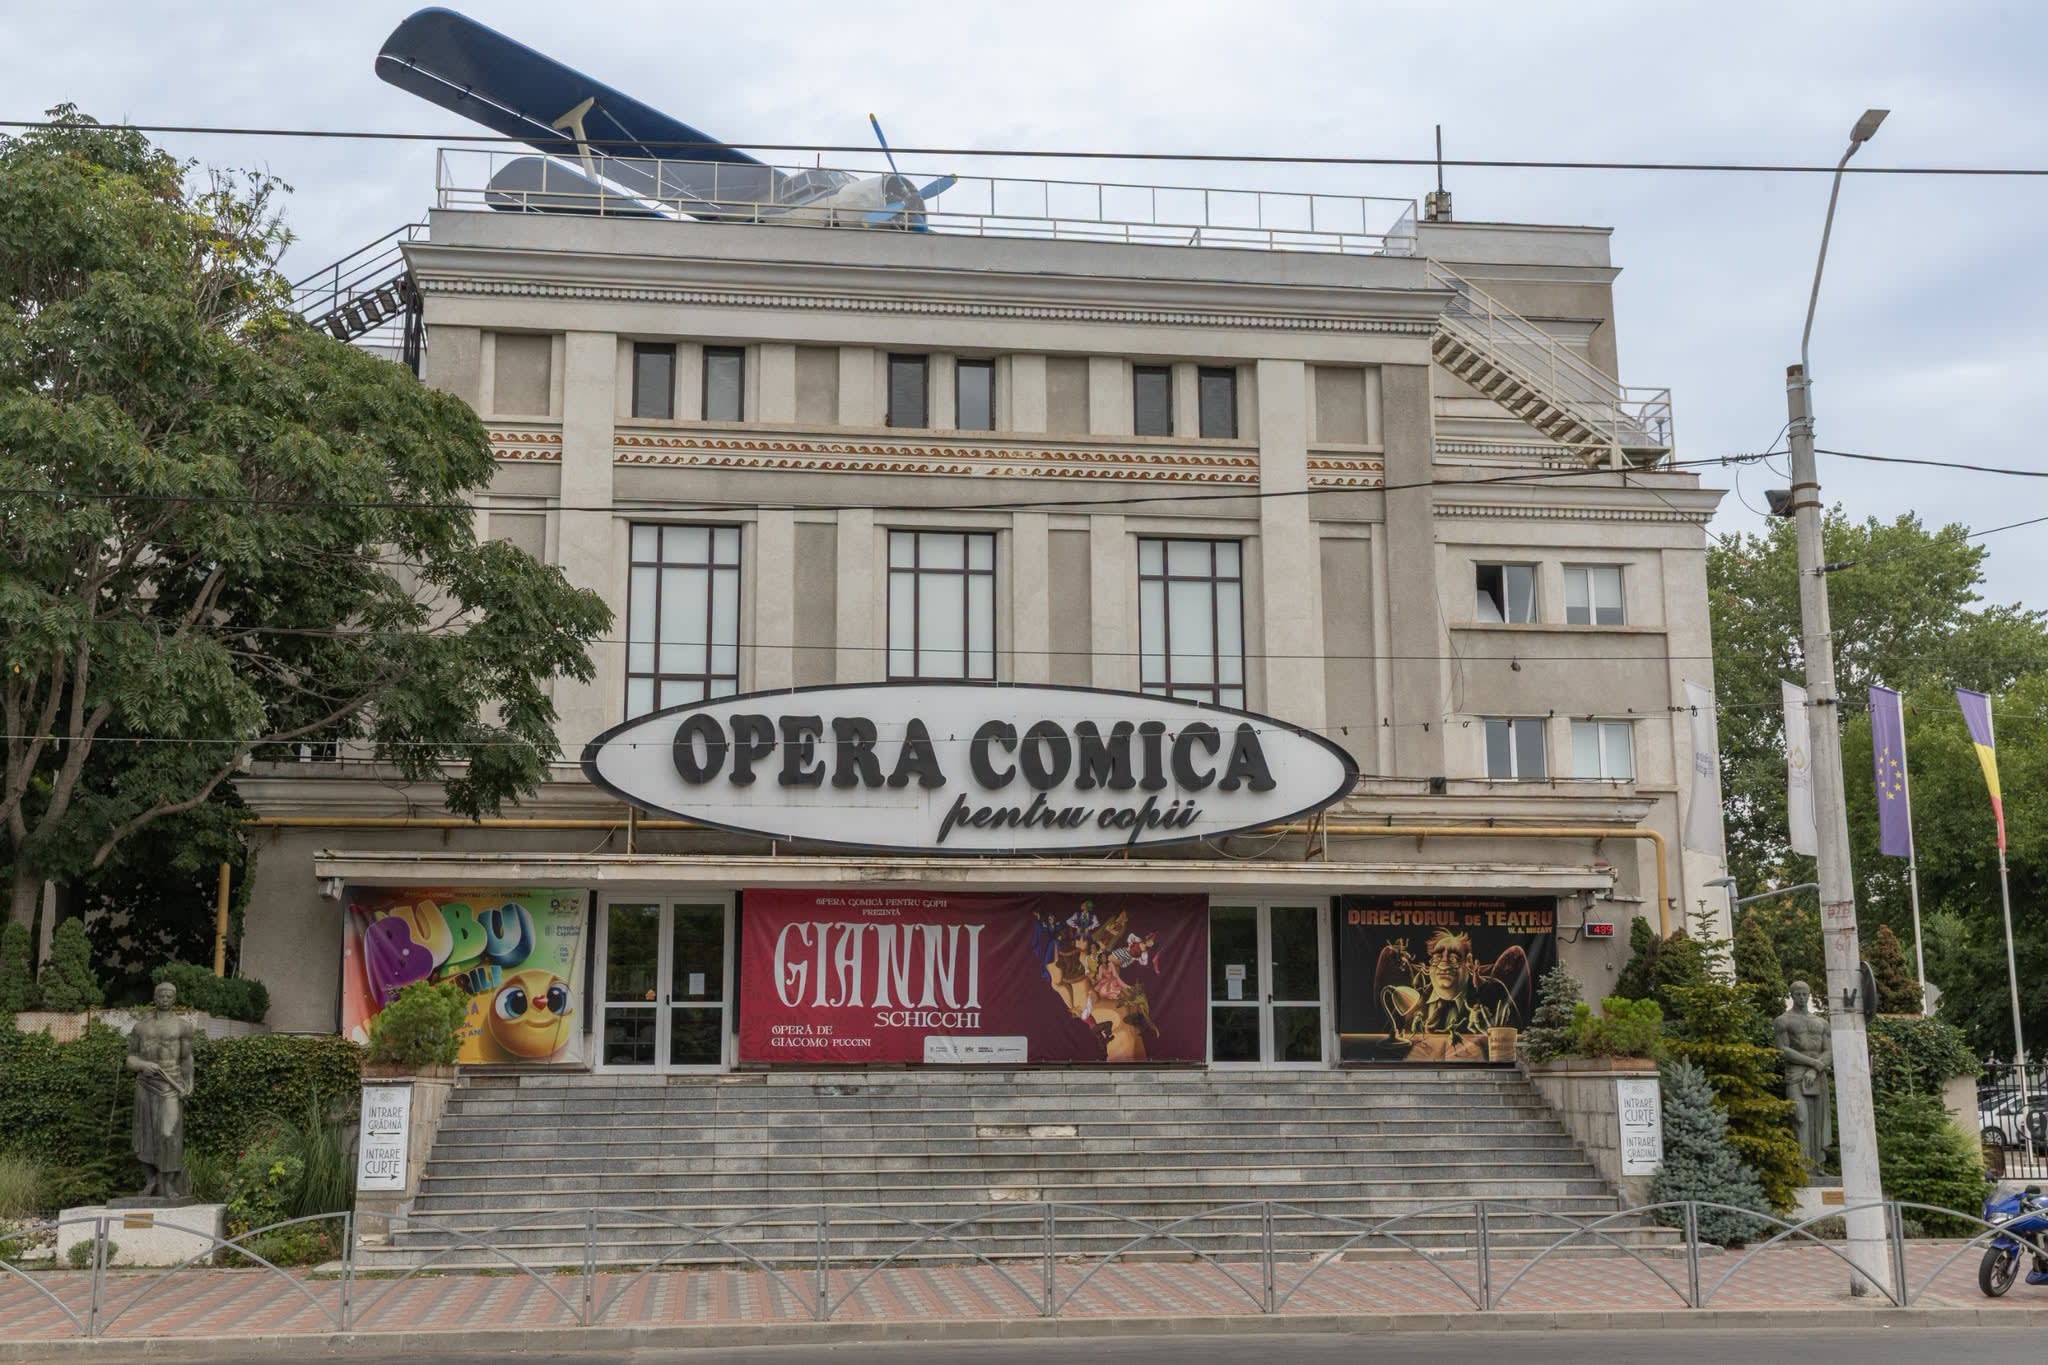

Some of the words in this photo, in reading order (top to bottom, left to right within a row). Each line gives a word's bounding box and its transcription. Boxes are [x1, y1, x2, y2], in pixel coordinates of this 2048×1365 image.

[671, 713, 947, 789] OPERA
[968, 718, 1277, 792] COMICA
[936, 791, 1095, 845] pentru
[1098, 795, 1203, 846] copii
[885, 897, 920, 907] PENTRU
[1348, 909, 1460, 926] DIRECTORUL
[1485, 910, 1553, 926] TEATRU
[364, 899, 536, 1005] BUBU
[774, 921, 986, 1009] GIANNI
[874, 1011, 981, 1028] SCHICCHI
[816, 1025, 833, 1035] DE
[771, 1038, 828, 1047] GIACOMO
[832, 1038, 871, 1047] PUCCINI
[1623, 1097, 1655, 1109] INTRARE
[367, 1106, 404, 1118] INTRARE
[1624, 1109, 1656, 1122] CURTE
[1626, 1136, 1657, 1147] INTRARE
[366, 1148, 401, 1160] INTRARE
[364, 1160, 400, 1174] CURTE
